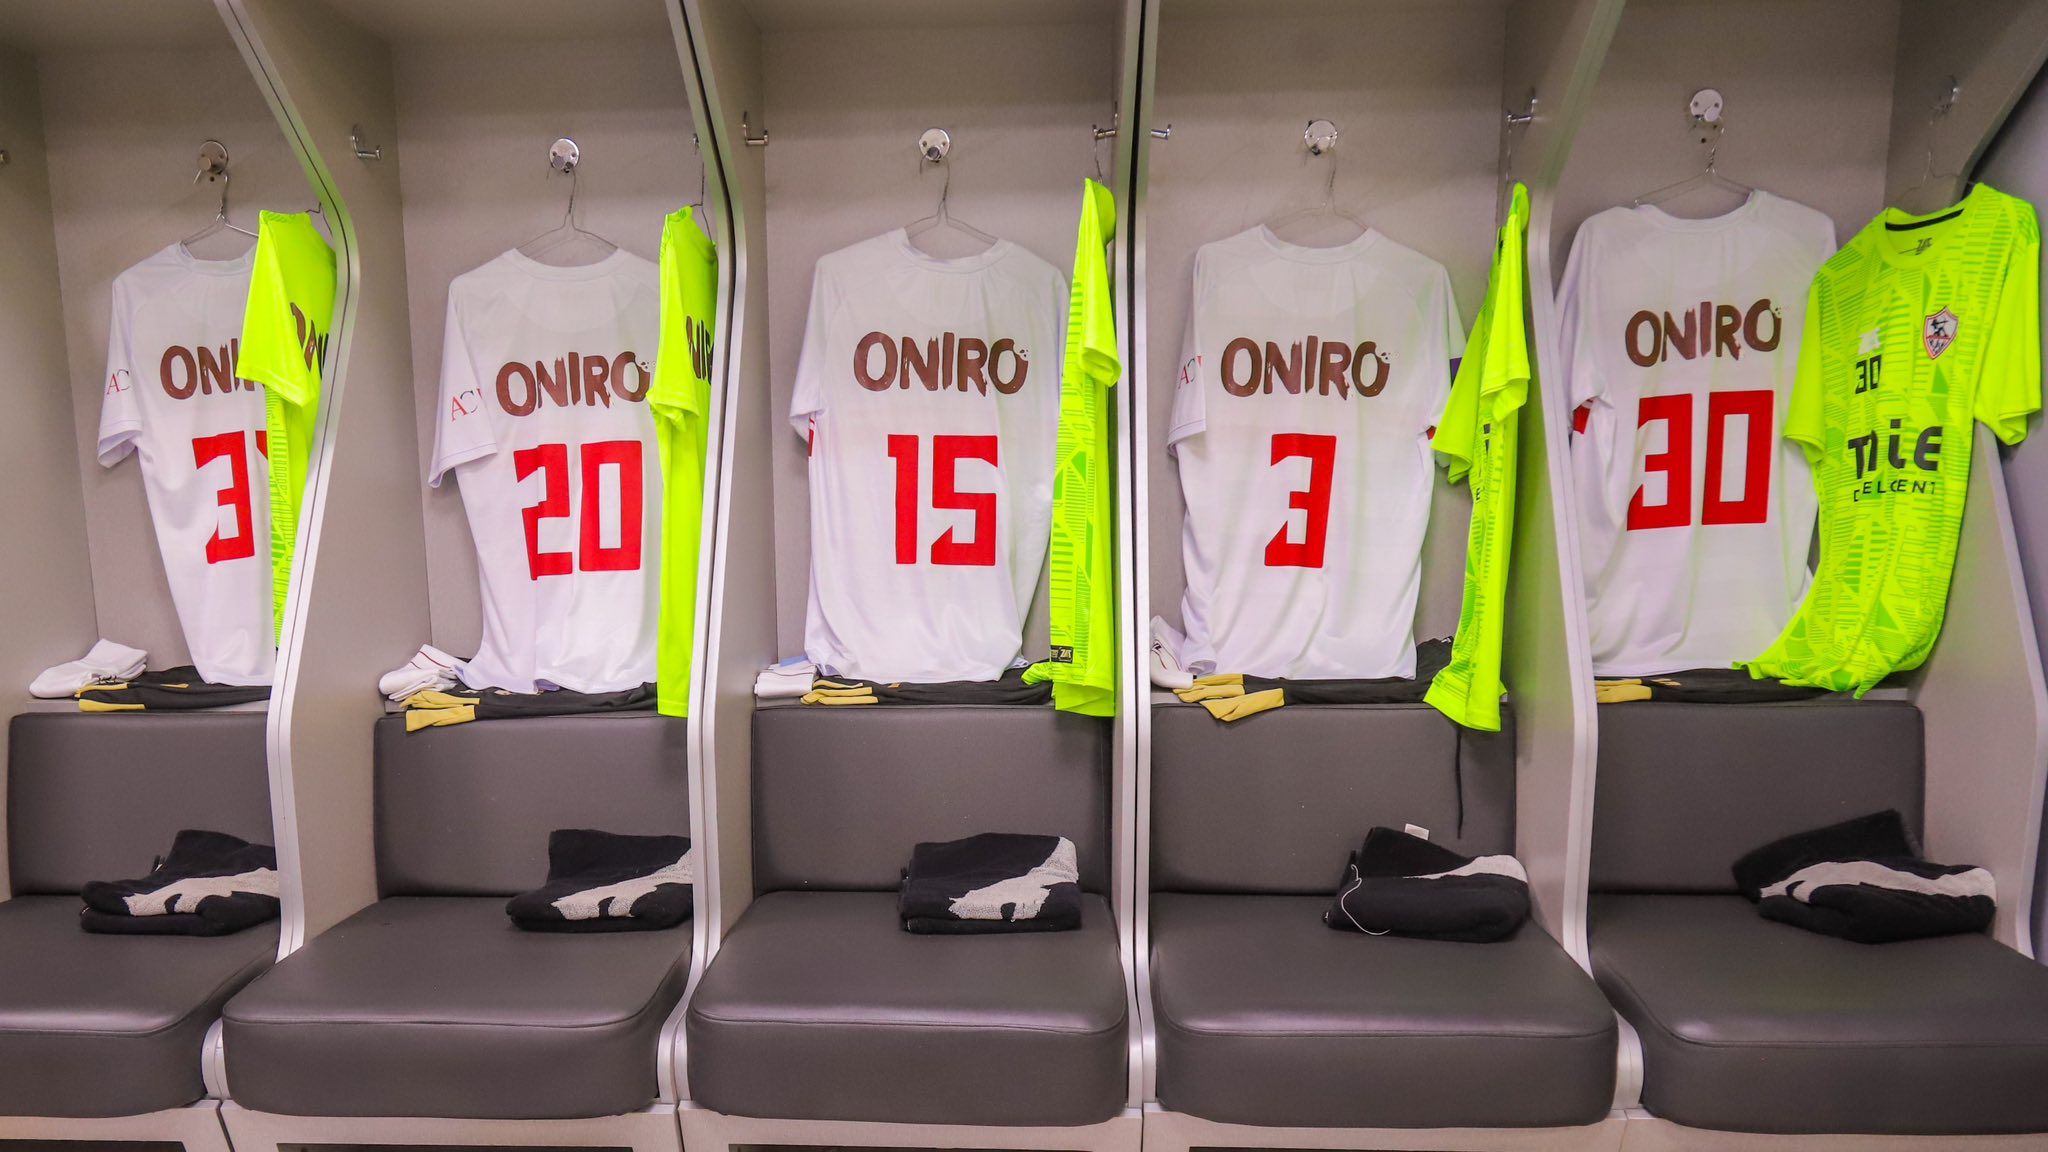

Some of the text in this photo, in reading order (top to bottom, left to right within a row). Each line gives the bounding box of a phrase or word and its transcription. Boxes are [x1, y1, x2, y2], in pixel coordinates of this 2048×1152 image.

[853, 331, 1029, 397] ONIRO
[1625, 298, 1782, 367] ONIRO
[496, 351, 652, 416] ONIRO
[1221, 335, 1391, 400] ONIRO
[1855, 354, 1882, 394] 30
[1627, 390, 1774, 531] 30
[514, 440, 642, 580] 20
[888, 434, 998, 566] 15
[1264, 433, 1337, 568] 3
